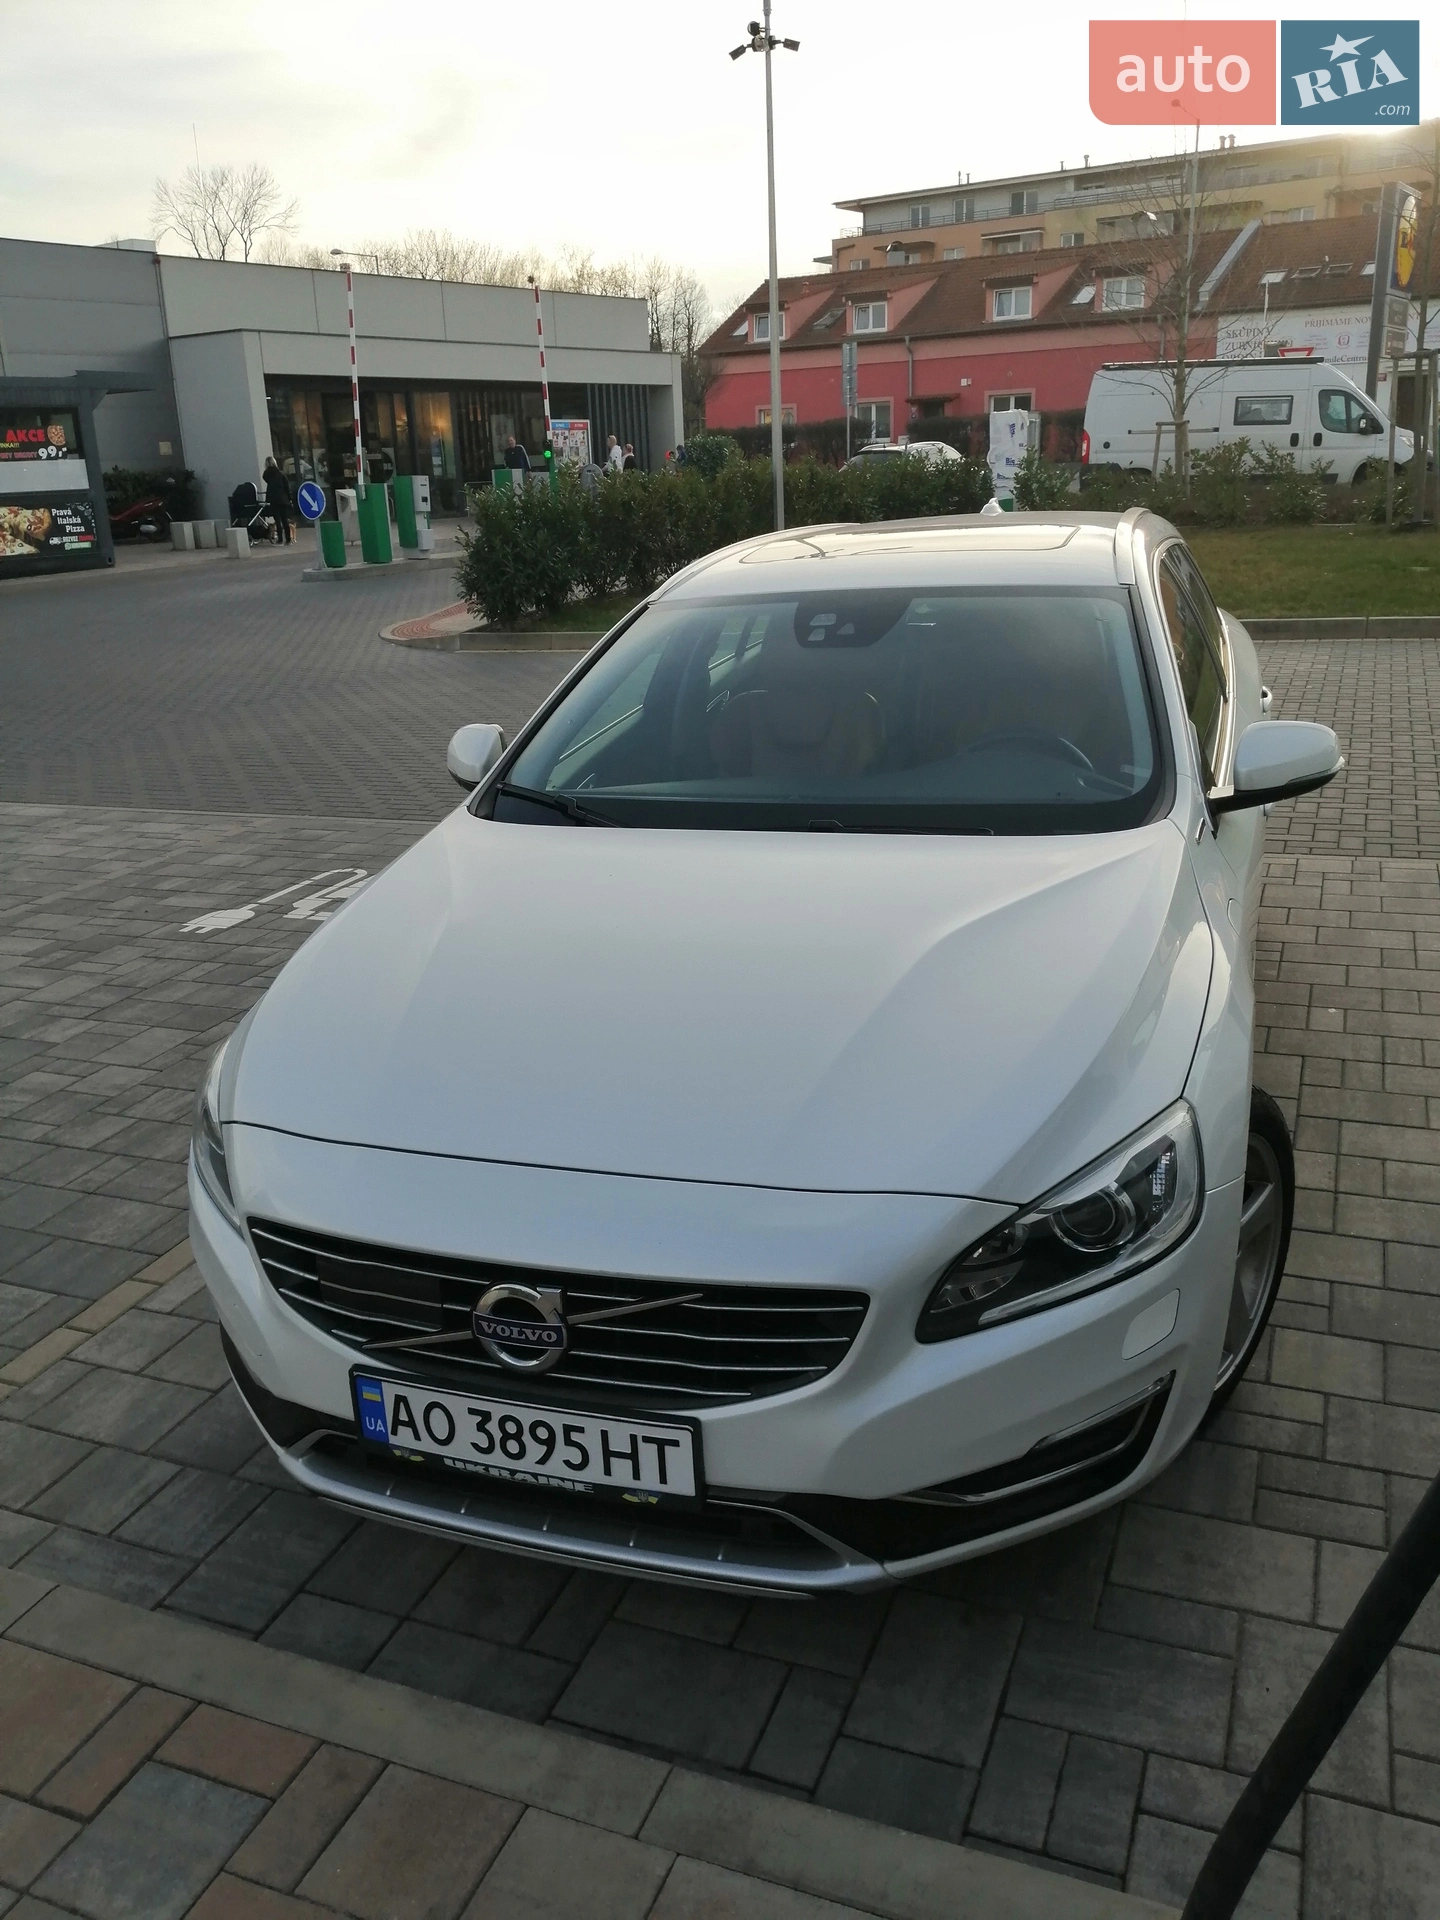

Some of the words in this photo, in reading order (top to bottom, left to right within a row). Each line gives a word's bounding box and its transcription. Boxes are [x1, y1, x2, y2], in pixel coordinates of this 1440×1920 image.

[1323, 354, 1368, 363] mileCentru
[6, 429, 45, 442] AKCE
[51, 508, 72, 516] Pravá
[65, 525, 85, 533] Pizza
[479, 1320, 558, 1343] VOLVO
[366, 1417, 386, 1433] UA
[390, 1393, 456, 1447] AO
[466, 1406, 590, 1472] 3895
[599, 1428, 681, 1485] HT
[443, 1457, 595, 1494] UKRAINE
